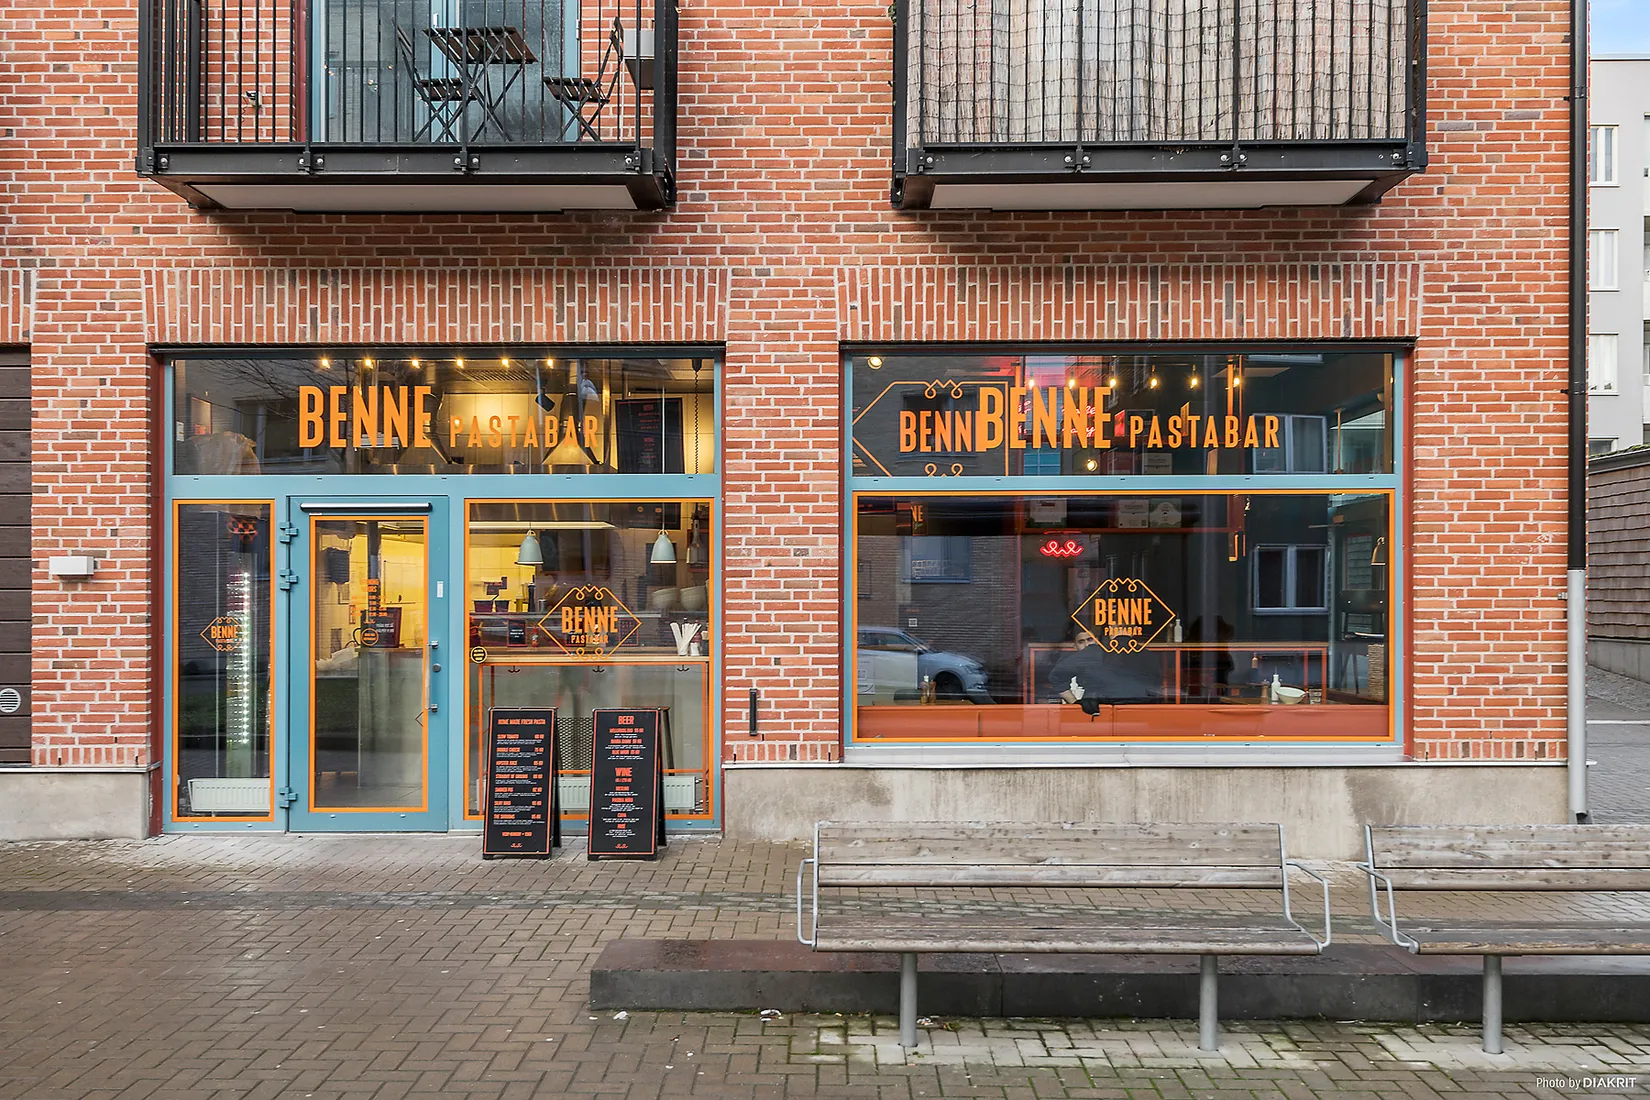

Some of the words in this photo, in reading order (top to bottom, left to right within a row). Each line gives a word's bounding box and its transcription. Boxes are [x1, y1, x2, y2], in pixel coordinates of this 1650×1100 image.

[299, 386, 432, 448] BENNE
[450, 415, 598, 448] PASTABAR
[979, 387, 1111, 448] BENNE
[1129, 415, 1279, 448] PASTABAR
[1094, 598, 1152, 626] BENNE
[561, 606, 618, 633] BENNE
[211, 625, 239, 639] BENNE
[1104, 626, 1143, 636] PASTABAR
[570, 635, 609, 644] PASTABAR
[618, 716, 634, 724] BEER
[615, 768, 632, 776] WINE
